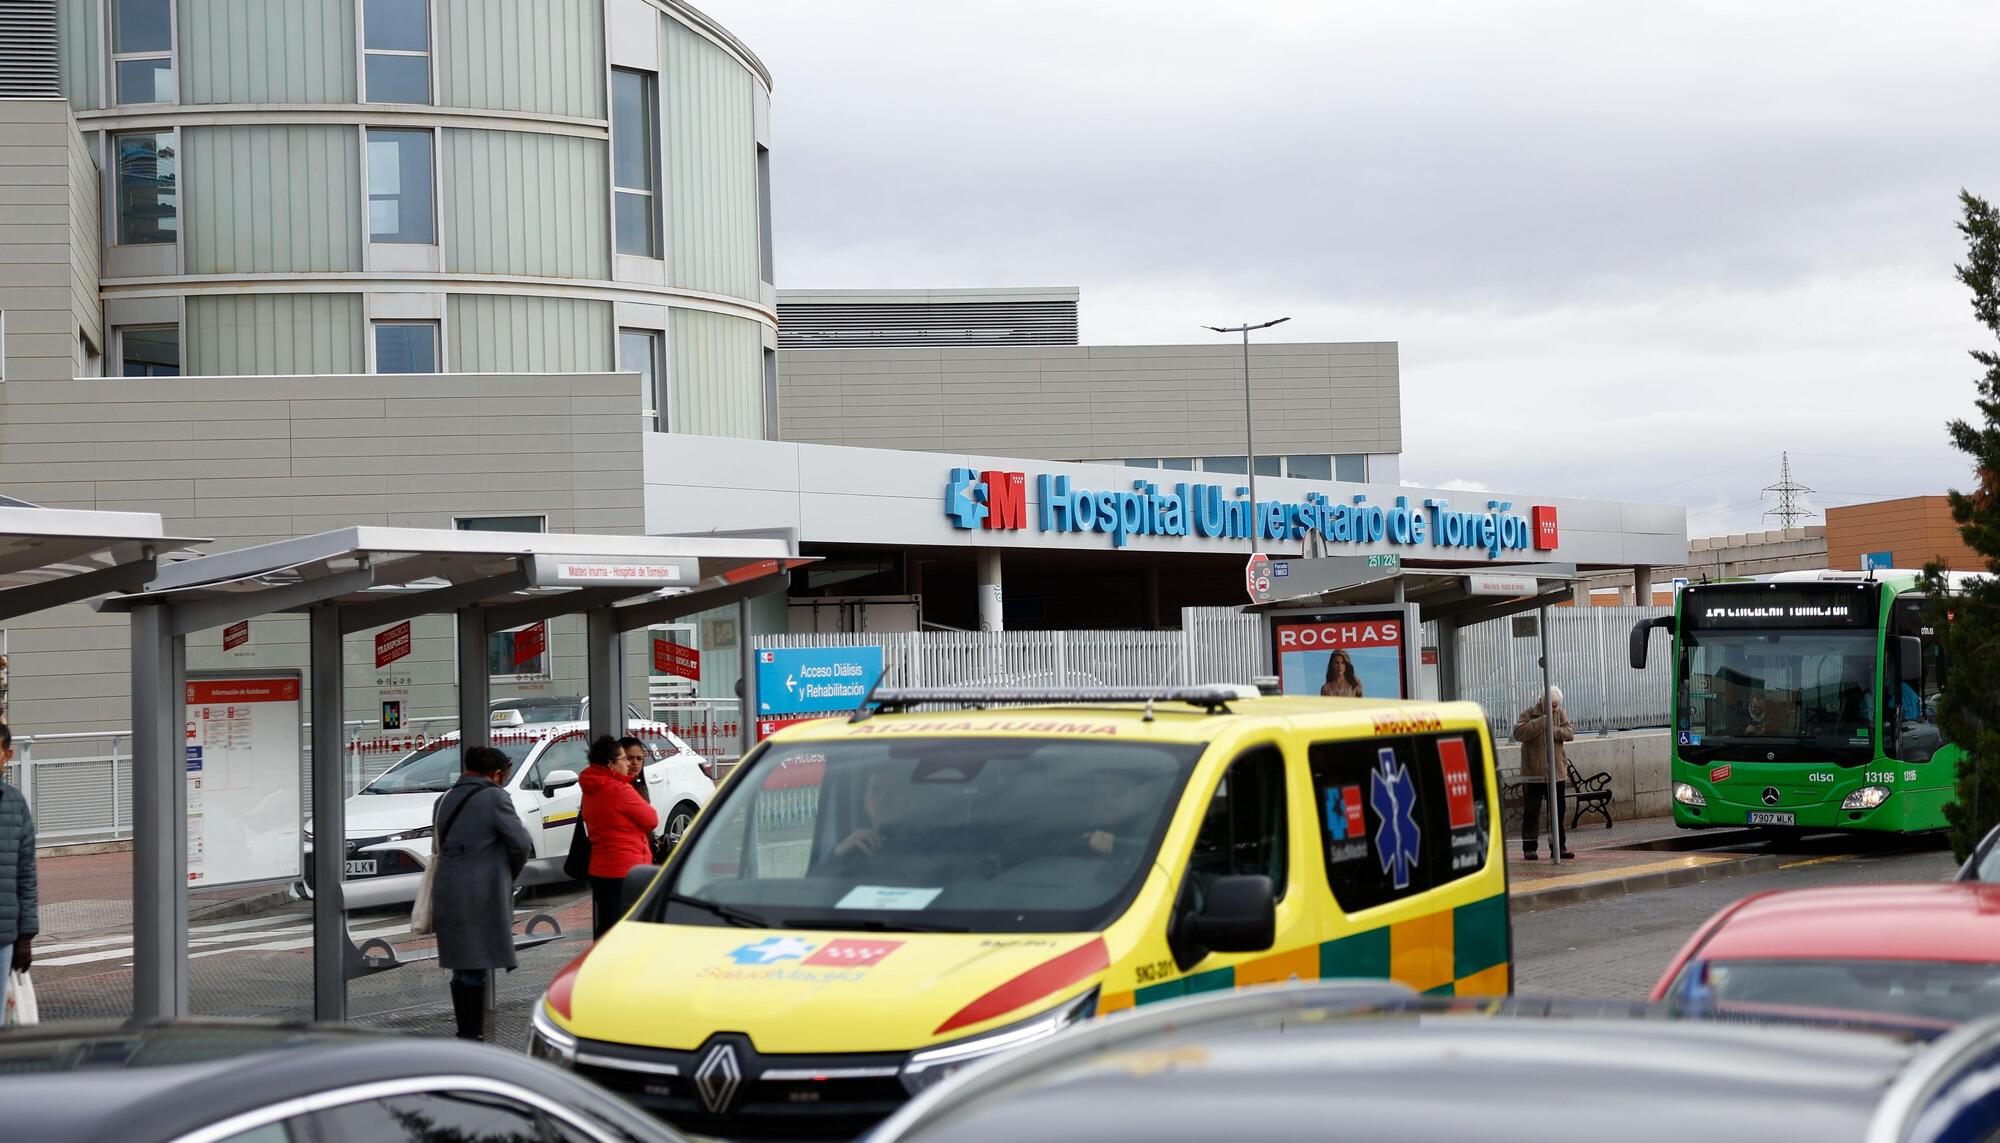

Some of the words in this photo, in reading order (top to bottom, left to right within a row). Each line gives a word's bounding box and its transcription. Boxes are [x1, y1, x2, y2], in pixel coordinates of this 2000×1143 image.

[1038, 474, 1190, 547] Hospital
[1193, 484, 1385, 543] Universitario
[1388, 496, 1425, 545] de
[1425, 499, 1529, 559] Torrejón
[1368, 555, 1381, 567] 251
[1383, 554, 1397, 566] 224
[568, 566, 587, 577] Mateo
[589, 566, 608, 577] Inurria
[613, 566, 637, 579] Hospital
[638, 567, 645, 577] de
[646, 566, 669, 579] Torrejón
[1280, 624, 1398, 646] ROCHAS
[377, 634, 409, 654] TRANSPORTES
[800, 664, 832, 678] Acceso
[834, 662, 863, 677] Diálisis
[799, 687, 805, 702] y
[806, 682, 865, 698] Rehabilitación
[1808, 772, 1834, 782] alsa
[1865, 771, 1895, 783] 13195
[1904, 770, 1917, 782] 13195
[1753, 813, 1775, 823] 7907
